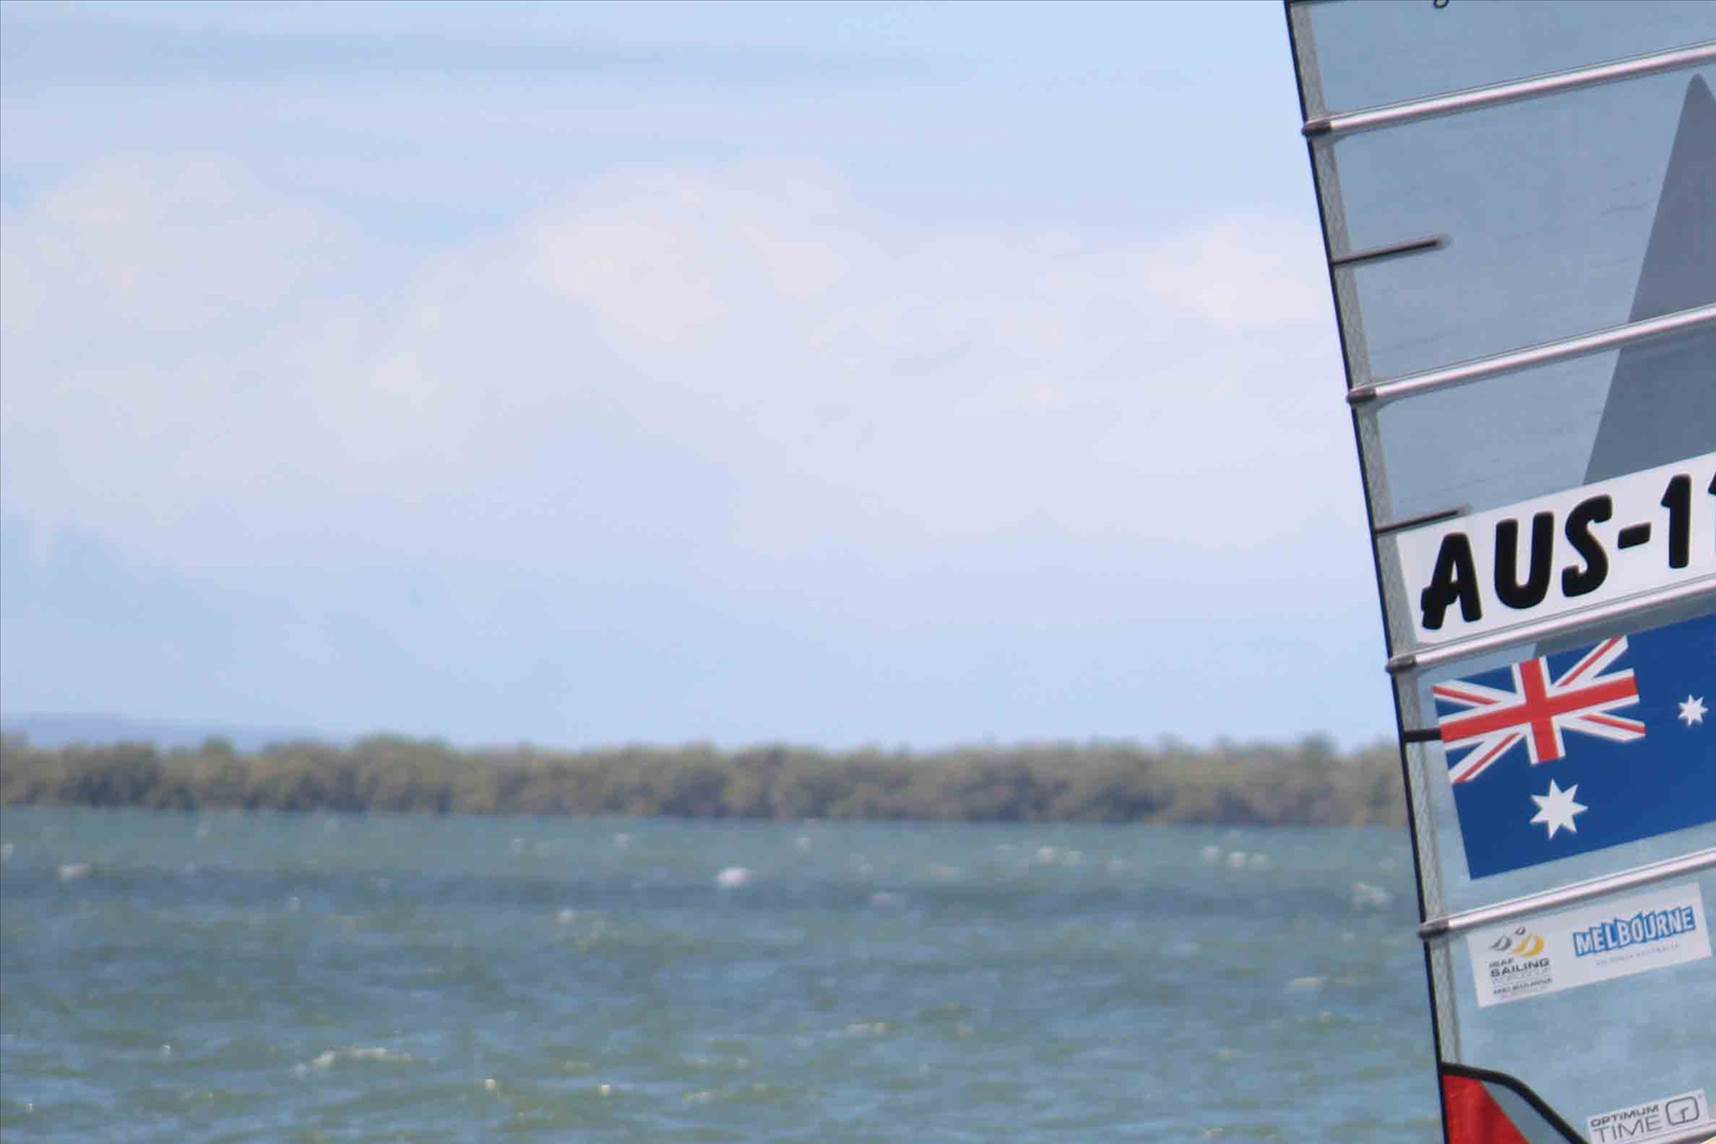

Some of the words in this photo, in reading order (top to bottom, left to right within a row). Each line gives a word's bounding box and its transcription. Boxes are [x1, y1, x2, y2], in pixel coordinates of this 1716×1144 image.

[1573, 906, 1696, 957] MELBOURNE
[1490, 957, 1549, 977] SAILING
[1590, 1104, 1659, 1127] OPTIMUM
[1592, 1114, 1662, 1143] TIME
